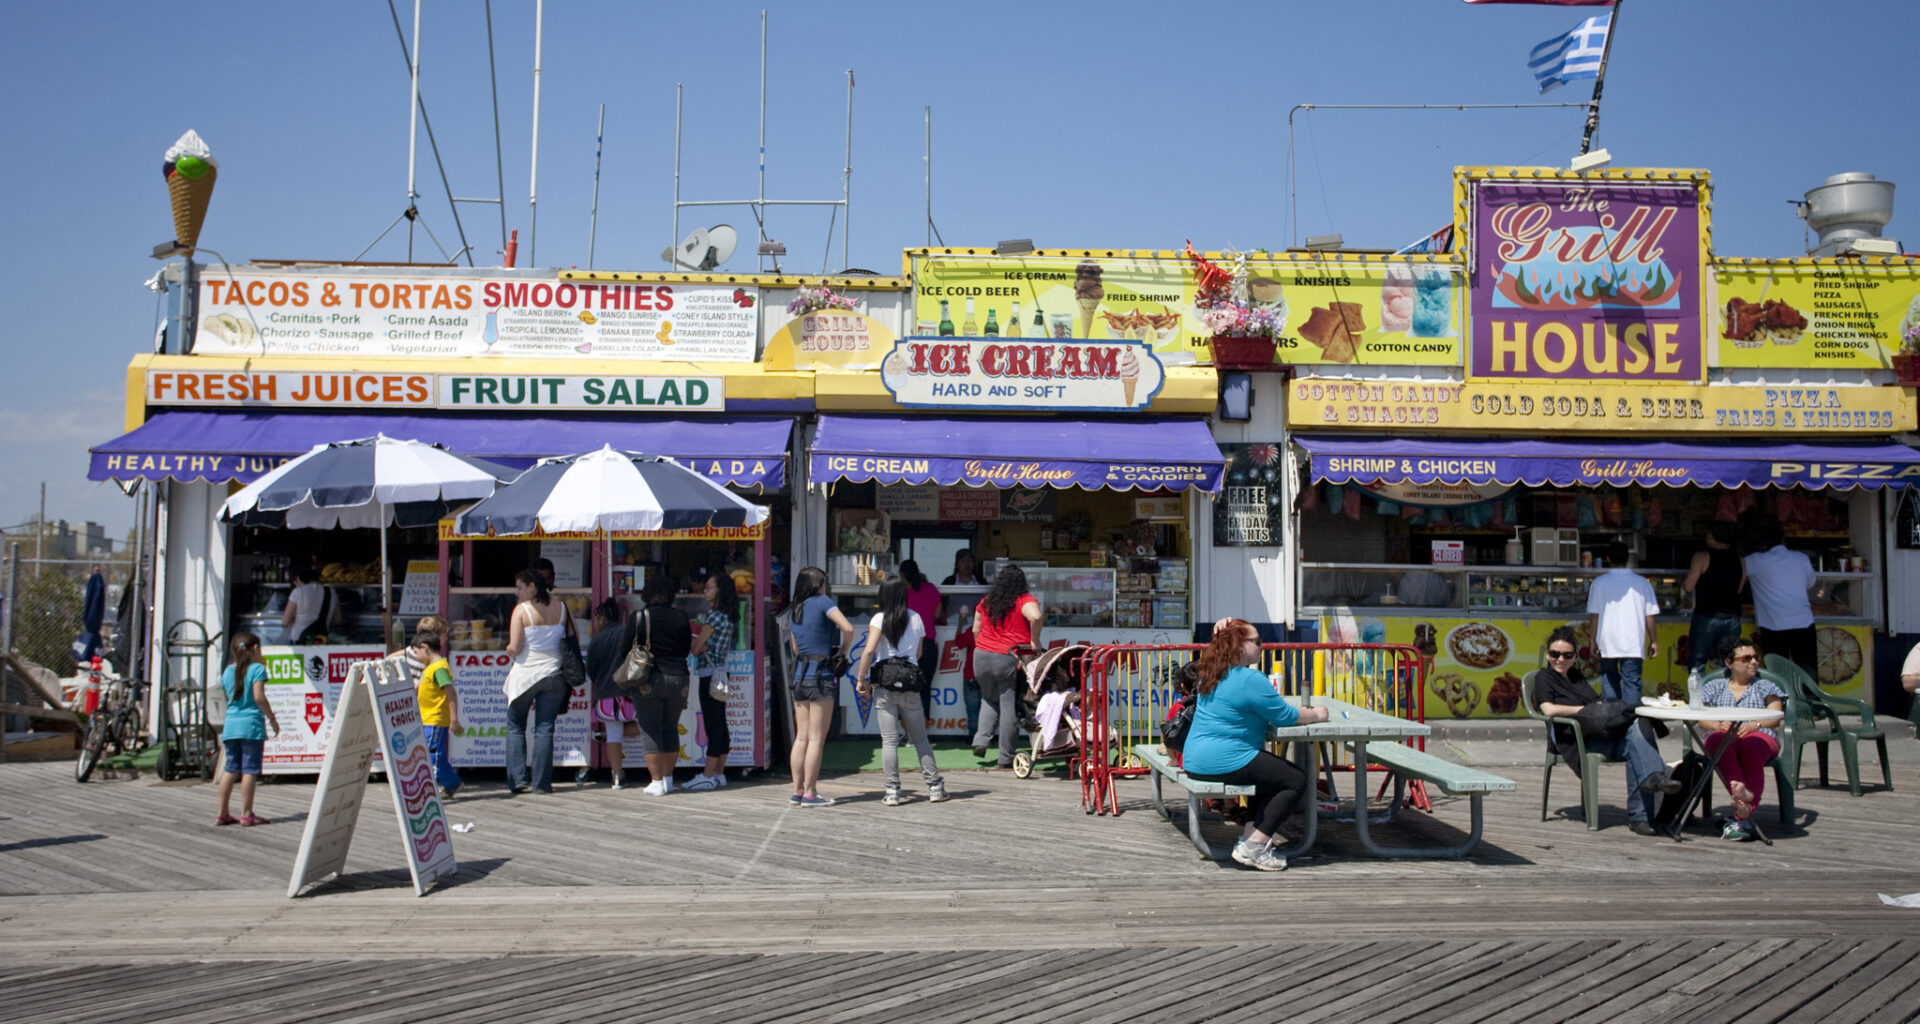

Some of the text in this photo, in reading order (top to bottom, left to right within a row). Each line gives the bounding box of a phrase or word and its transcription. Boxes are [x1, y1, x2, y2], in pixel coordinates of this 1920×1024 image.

[1560, 188, 1609, 213] The
[1491, 202, 1678, 264] Grill
[1004, 272, 1066, 281] ICE CREAM
[1295, 277, 1350, 286] KNISHES
[206, 280, 472, 310] TACOS & TORTAS
[483, 282, 674, 311] SMOOTHIES
[922, 286, 1020, 297] ICE COLD BEER
[1107, 294, 1180, 302] FRIED SHRIMP
[270, 312, 360, 324] Carnitas Pork
[388, 314, 468, 326] Carne Asada
[804, 316, 868, 332] GRILL
[260, 326, 374, 341] Chorizo Sausage
[388, 329, 463, 341] Grilled Beef
[266, 341, 360, 353] Pollo Chicken
[390, 344, 458, 354] Vegetarian
[802, 335, 870, 351] HOUSE
[1366, 344, 1452, 354] COTTON CANDY
[1490, 321, 1682, 374] HOUSE
[907, 343, 1122, 380] ICE CREAM
[154, 374, 428, 402] FRESH JUICES
[452, 378, 710, 406] FRUIT SALAD
[932, 382, 1066, 398] HARD AND SOFT
[1296, 384, 1465, 404] COTTON CANDY
[1471, 394, 1704, 418] COLD SODA & BEER
[1765, 390, 1842, 408] PIZZA
[1322, 405, 1439, 424] & SNACKS
[1715, 410, 1894, 428] FRIES & KNISHES
[108, 455, 224, 472] HEALTHY
[690, 461, 766, 476] LADA
[828, 458, 929, 474] ICE CREAM
[964, 460, 1076, 480] Grill House
[1109, 465, 1202, 474] POPCORN
[1329, 458, 1496, 475] SHRIMP & CHICKEN
[1580, 460, 1689, 478] Grill House
[1772, 463, 1920, 480] PIZZA
[1119, 472, 1207, 481] CANDIES
[1228, 486, 1266, 505] FREE
[1228, 505, 1267, 516] FIREWORKS
[1228, 516, 1268, 529] FRIDAY
[1228, 528, 1270, 542] NIGHTS
[1433, 550, 1462, 562] CLOSED
[385, 696, 413, 714] HEALTHY
[930, 688, 958, 706] RD
[462, 706, 492, 715] (Grilled
[391, 711, 416, 728] CHOICE
[468, 716, 507, 724] Vegetaria
[925, 718, 968, 730] PING
[282, 734, 304, 742] (Pork)
[474, 739, 502, 748] Regular
